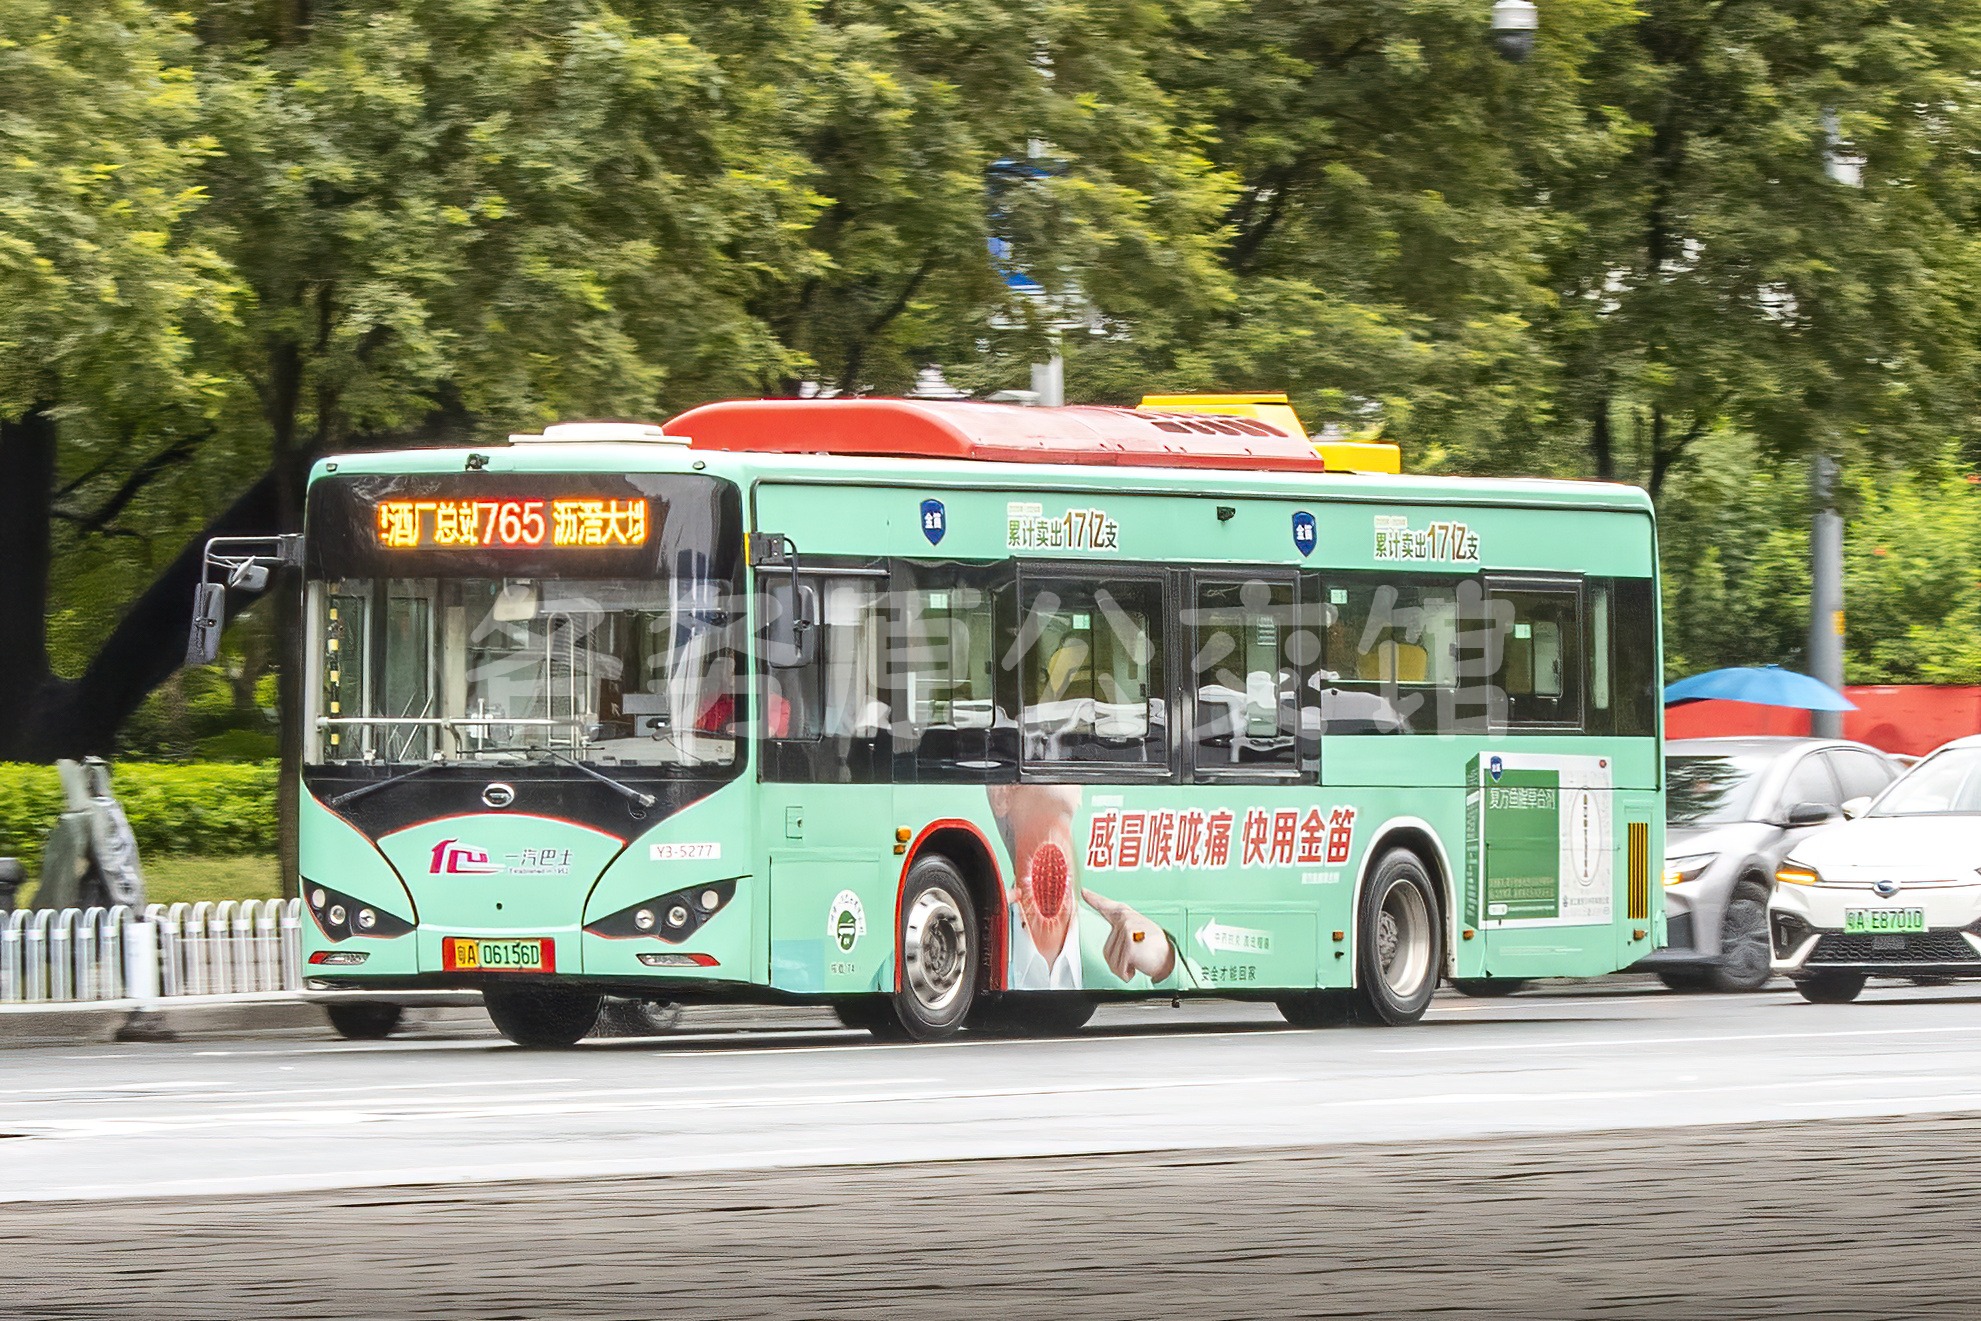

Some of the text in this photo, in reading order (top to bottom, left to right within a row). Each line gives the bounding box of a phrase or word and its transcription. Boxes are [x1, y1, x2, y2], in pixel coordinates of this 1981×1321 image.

[478, 501, 545, 544] 765
[1008, 510, 1118, 549] 累计卖出17亿支
[1375, 523, 1479, 561] 累计卖出17亿支
[656, 844, 713, 859] Y3-5277
[1087, 808, 1355, 868] 感冒喉咙痛 快用金笛
[505, 849, 573, 866] 一汽巴士
[483, 945, 540, 965] 06156D
